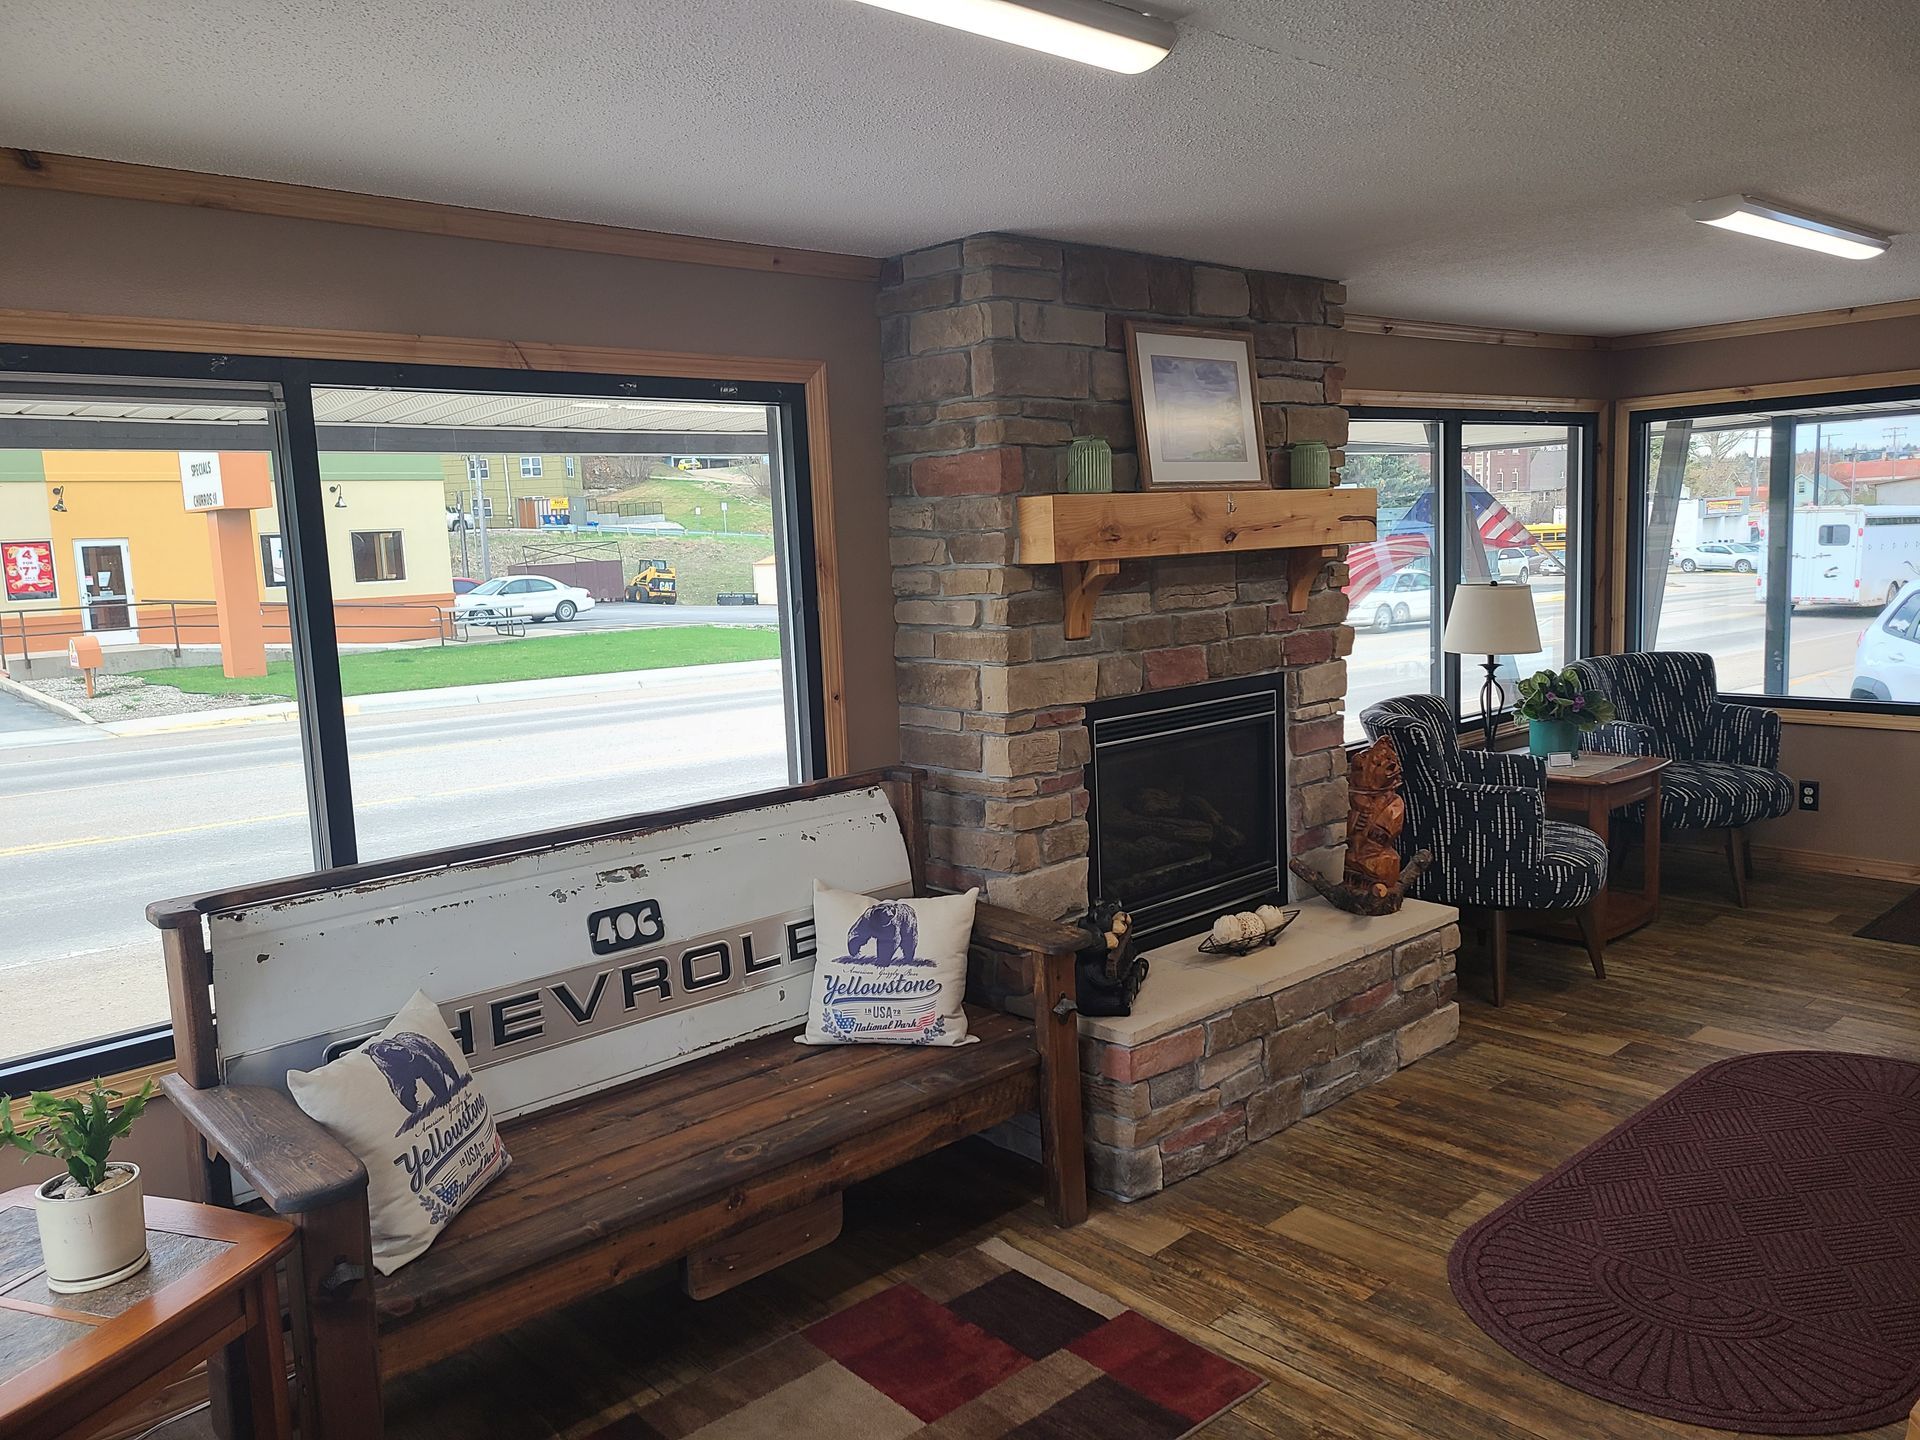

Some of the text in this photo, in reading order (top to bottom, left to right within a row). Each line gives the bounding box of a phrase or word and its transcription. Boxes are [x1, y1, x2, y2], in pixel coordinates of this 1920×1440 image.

[191, 461, 212, 477] SPECIALS
[193, 493, 212, 508] CHURROS
[22, 549, 32, 560] 4
[660, 582, 674, 591] CAT
[596, 907, 658, 945] 406
[823, 974, 942, 1005] Yellowstone
[872, 1006, 893, 1019] USA
[854, 1018, 919, 1033] National Park
[393, 1092, 489, 1195] Yellowstone
[464, 1143, 482, 1166] USA
